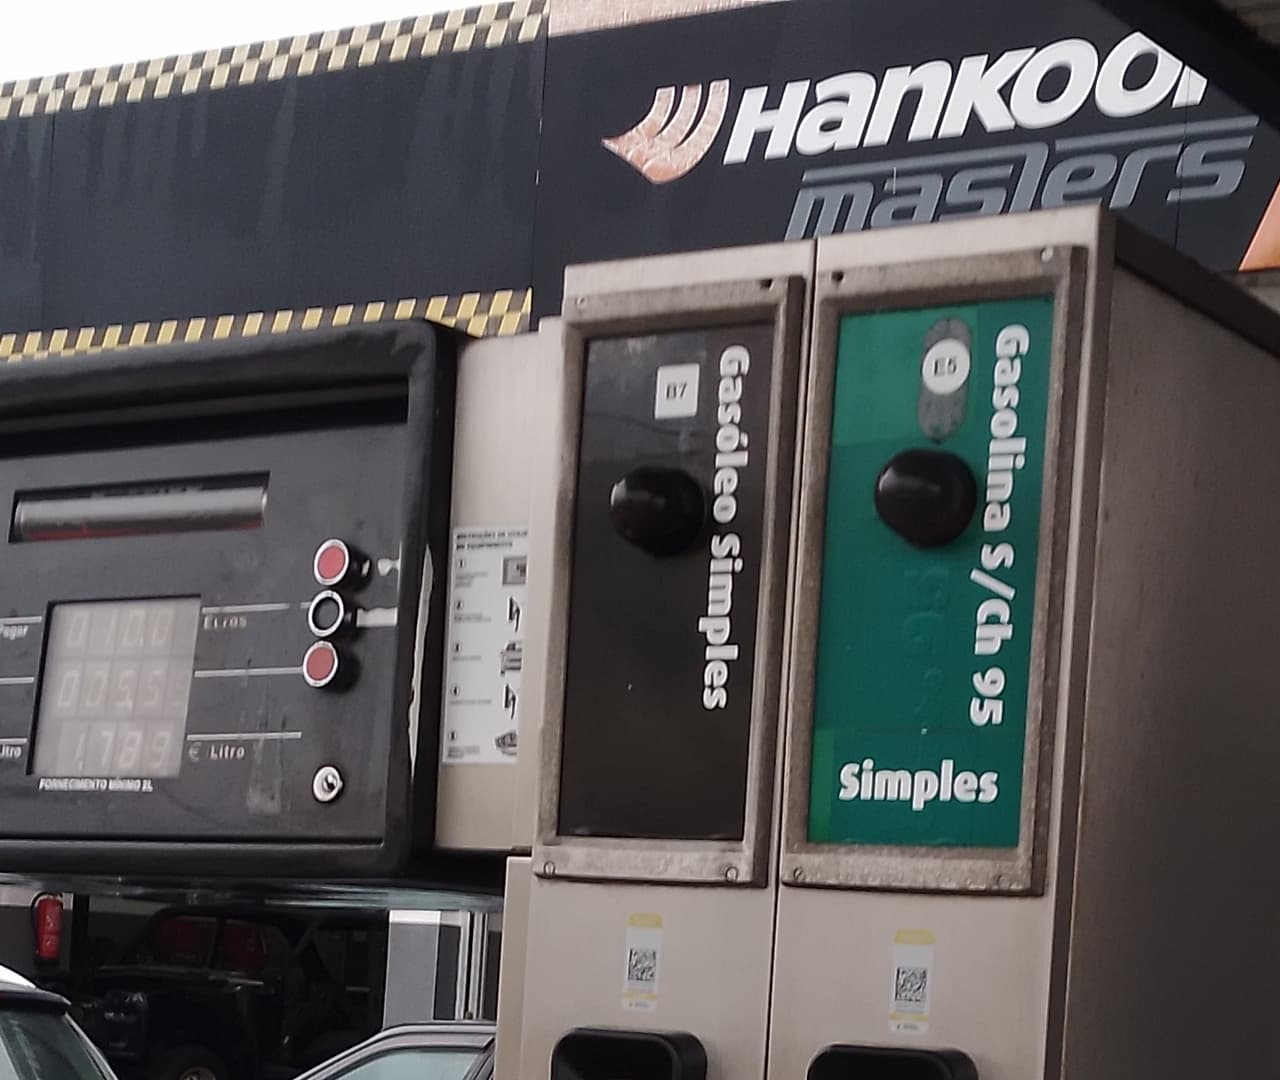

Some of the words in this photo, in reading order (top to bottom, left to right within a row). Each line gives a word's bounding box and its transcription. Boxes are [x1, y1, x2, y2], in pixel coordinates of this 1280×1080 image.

[666, 381, 688, 401] B7
[932, 355, 959, 378] E5
[712, 344, 751, 525] Gasóleo
[982, 325, 1030, 533] Gasolina
[698, 532, 744, 711] Simples
[969, 667, 1006, 727] 95
[209, 743, 247, 760] Litro
[838, 758, 999, 811] Simples
